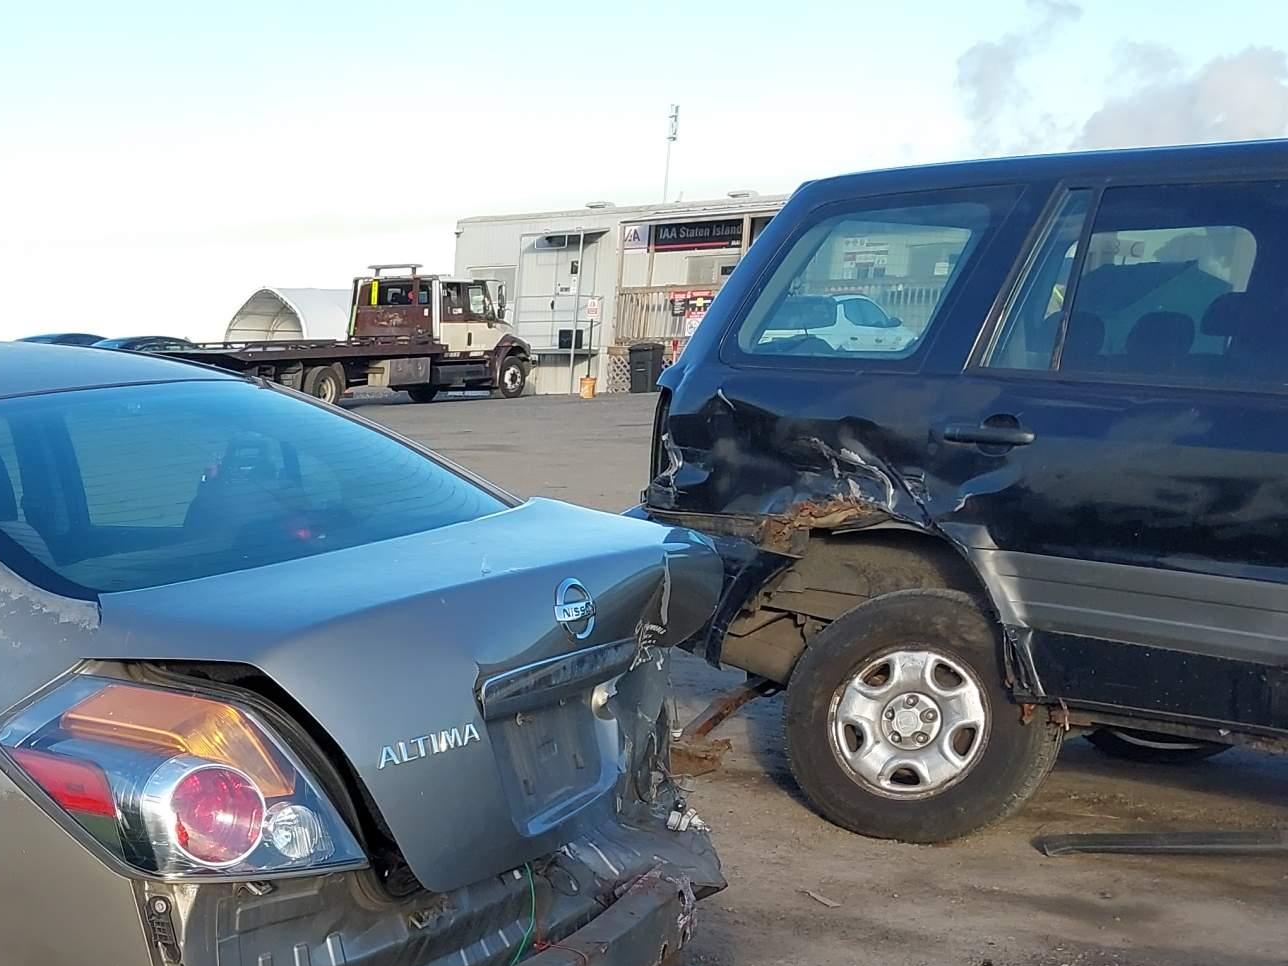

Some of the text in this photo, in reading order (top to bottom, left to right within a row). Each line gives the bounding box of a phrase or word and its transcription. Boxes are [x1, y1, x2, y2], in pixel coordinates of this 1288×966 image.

[659, 223, 743, 239] IAA Staten Island
[562, 602, 592, 619] NISS
[376, 722, 481, 770] ALTIMA
